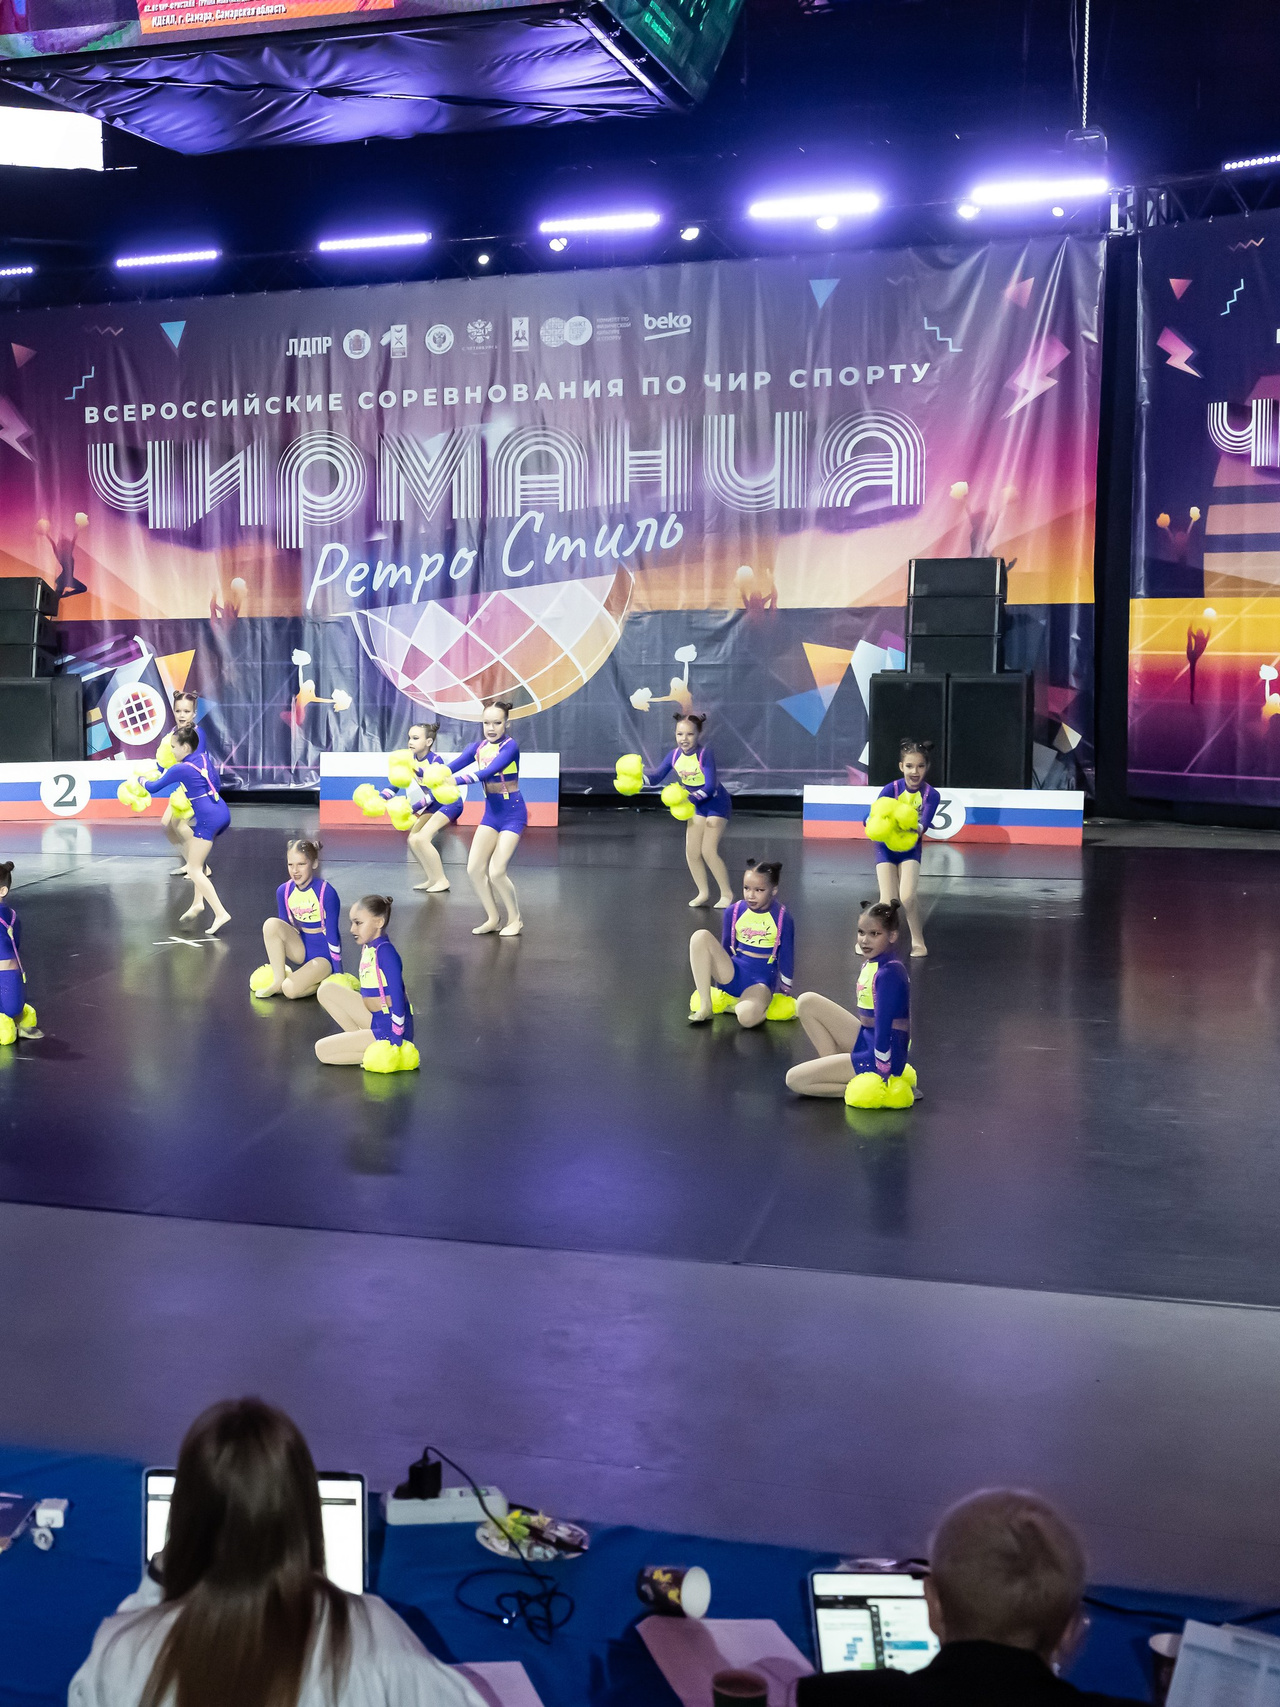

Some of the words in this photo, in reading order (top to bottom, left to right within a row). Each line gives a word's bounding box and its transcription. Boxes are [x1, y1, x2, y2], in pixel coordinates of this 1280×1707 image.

[186, 12, 215, 24] Самара,
[215, 8, 257, 20] Самарская
[256, 4, 287, 15] область
[644, 312, 692, 330] beko
[286, 336, 332, 358] ЛДПР
[85, 393, 343, 424] ВСЕРОССИЙСКИЕ
[358, 378, 624, 410] СОРЕВНОВАНИЯ
[642, 375, 687, 396] ПО
[704, 370, 772, 393] ЧИР
[789, 362, 932, 389] СПОРТУ
[306, 542, 478, 610] Ретро
[501, 510, 684, 578] Стиль
[53, 774, 77, 807] 2
[928, 799, 953, 831] 3
